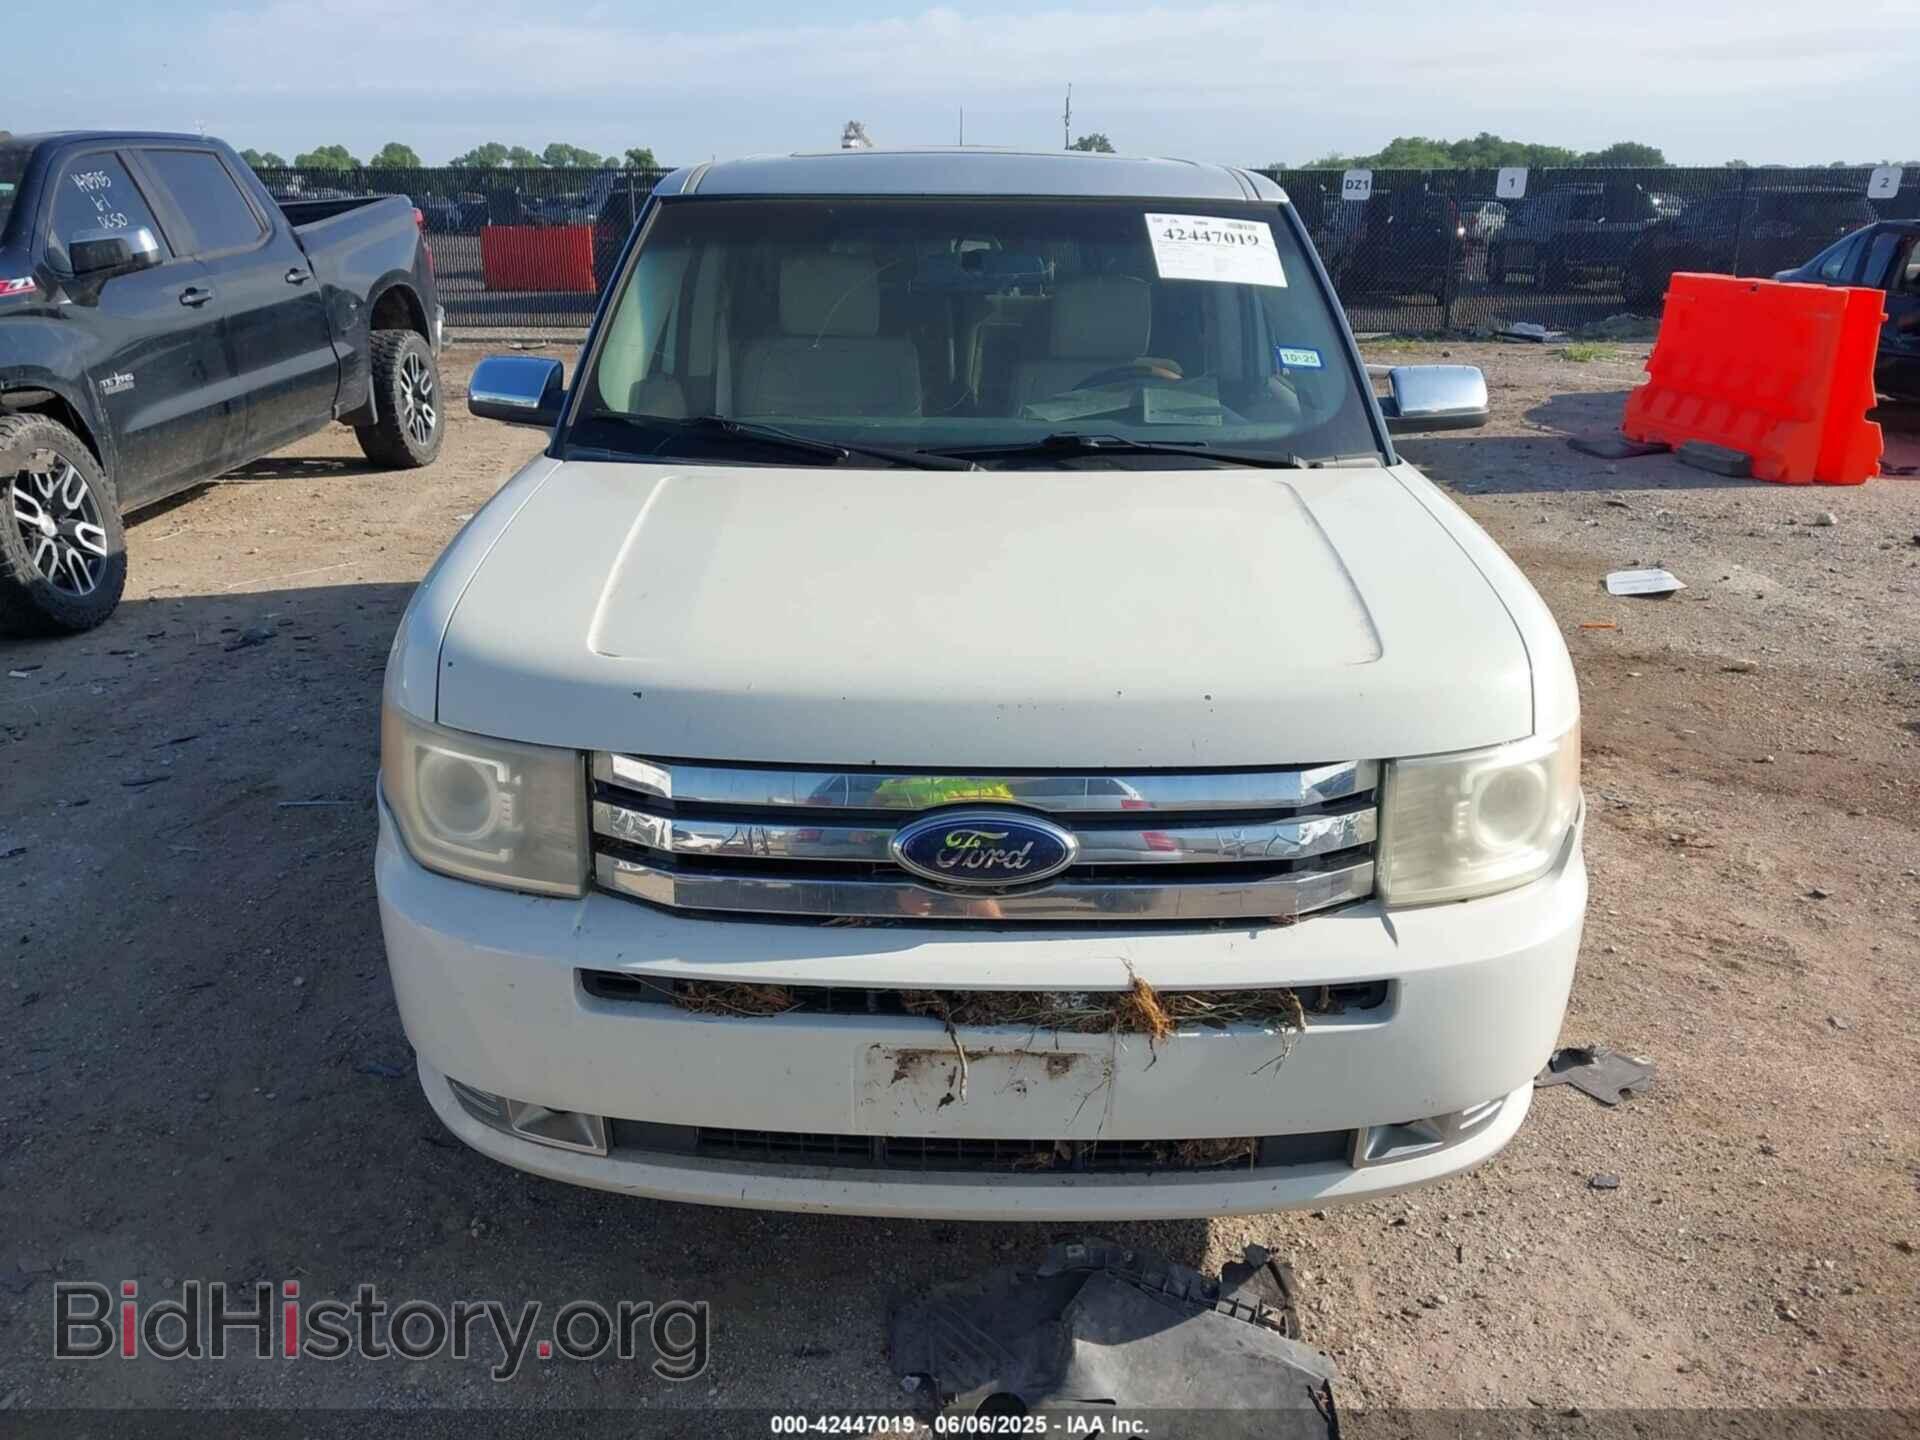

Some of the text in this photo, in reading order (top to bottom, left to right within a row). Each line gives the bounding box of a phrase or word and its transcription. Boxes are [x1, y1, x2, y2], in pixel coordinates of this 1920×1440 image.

[1345, 179, 1369, 190] DZ1
[1508, 177, 1516, 188] 1
[1880, 177, 1890, 188] 2
[1163, 227, 1259, 246] 42447019
[936, 828, 1035, 870] Ford
